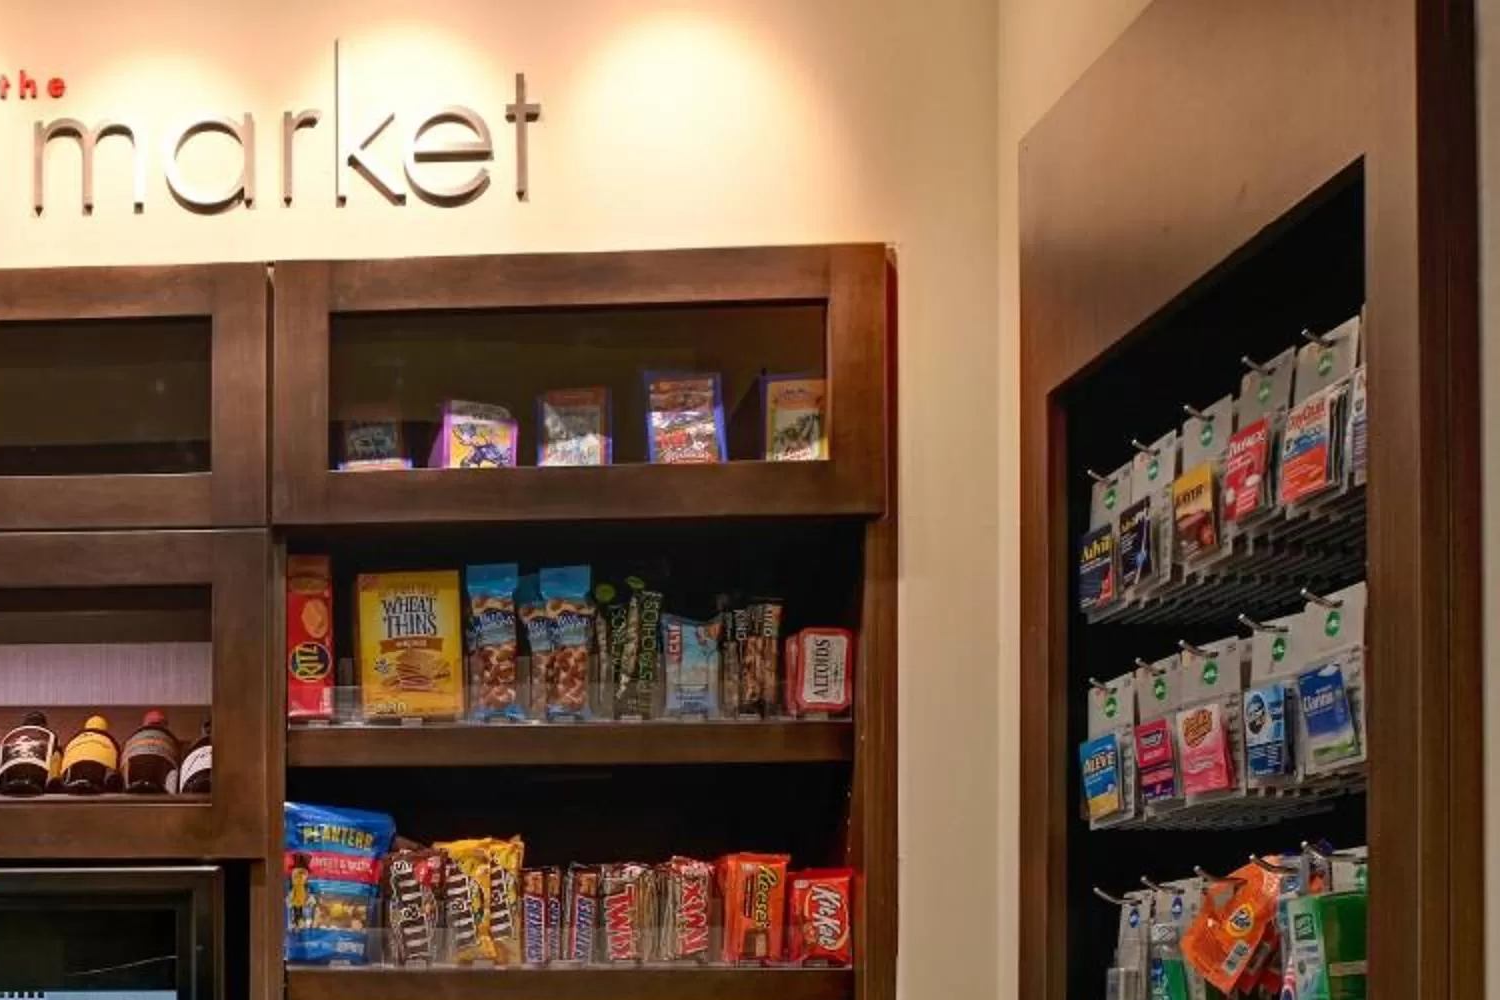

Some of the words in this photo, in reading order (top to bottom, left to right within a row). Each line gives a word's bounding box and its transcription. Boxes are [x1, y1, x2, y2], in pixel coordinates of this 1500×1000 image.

[33, 38, 541, 217] market
[381, 597, 437, 615] WHEAT
[383, 612, 438, 639] THINS
[811, 638, 831, 698] ALTOIDS
[605, 883, 637, 960] TWIX
[679, 881, 709, 956] TWIX
